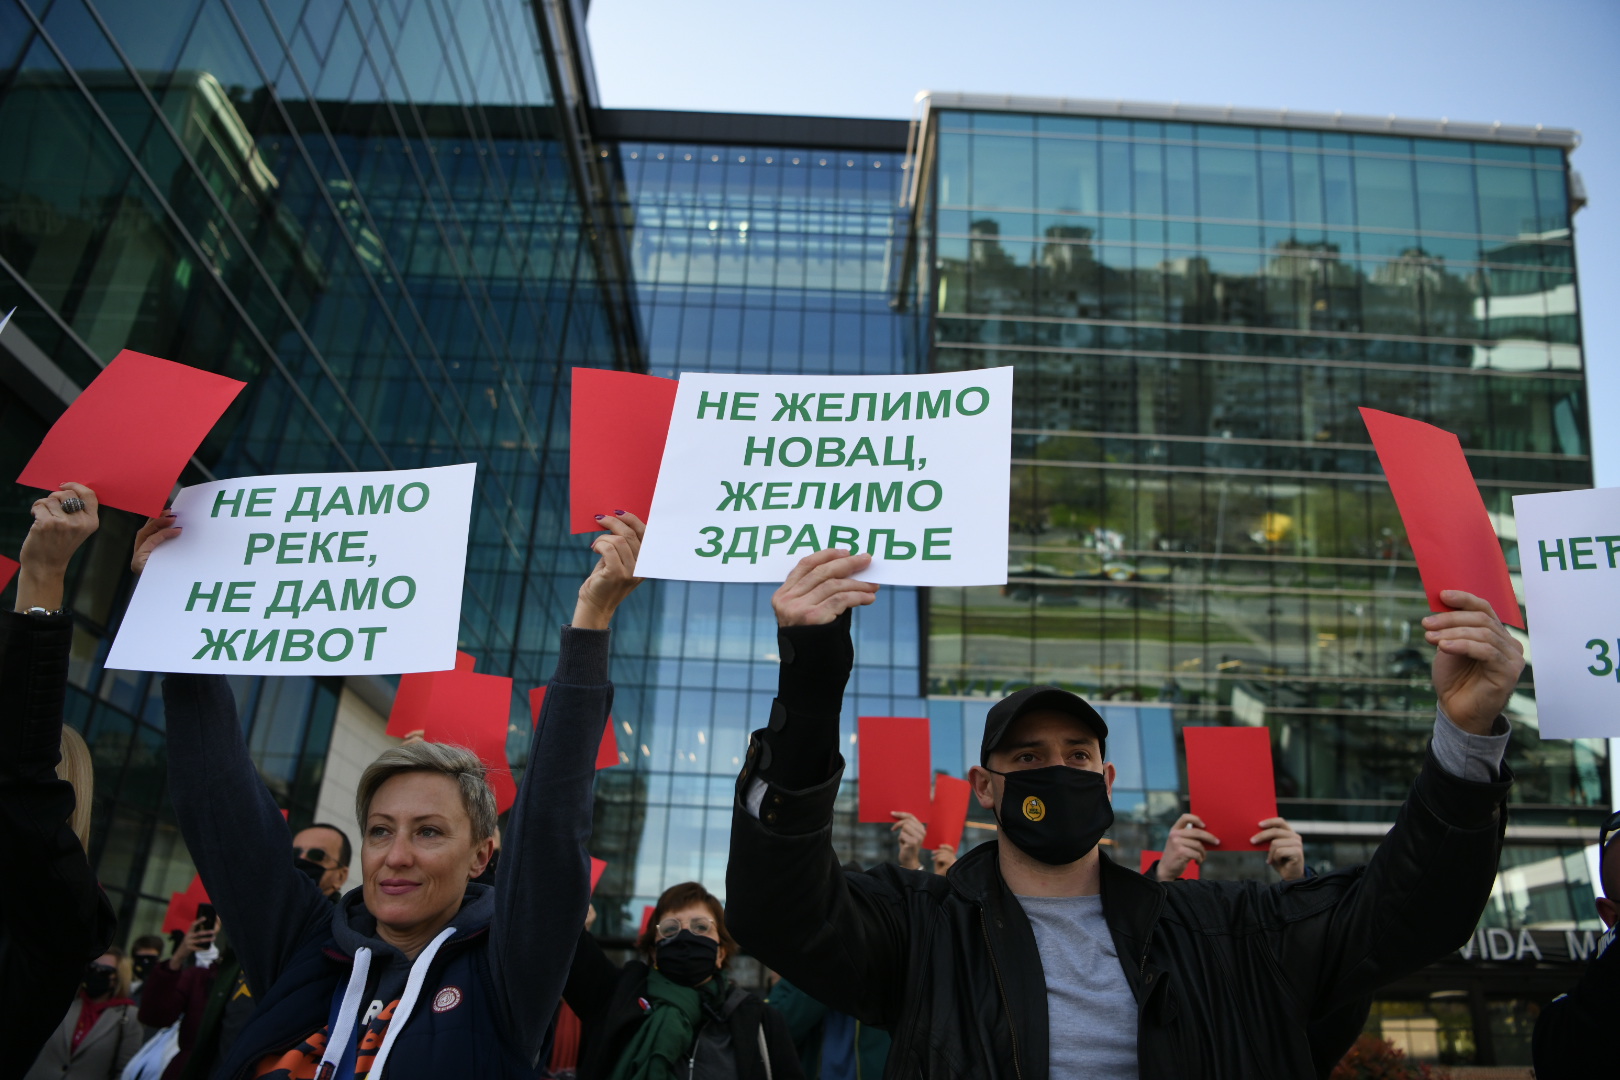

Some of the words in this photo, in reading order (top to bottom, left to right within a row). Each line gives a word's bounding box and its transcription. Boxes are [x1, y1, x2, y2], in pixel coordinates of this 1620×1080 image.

[696, 390, 760, 421] НЕ
[771, 386, 990, 422] ЖЕЛИМО
[743, 435, 927, 472] НОВАЦ,
[210, 487, 277, 518] НЕ
[284, 481, 430, 523] ДАМО
[716, 480, 943, 513] ЖЕЛИМО
[243, 530, 377, 568] РЕКЕ,
[694, 523, 953, 565] ЗДРАВЉЕ
[184, 581, 257, 613] НЕ
[263, 575, 417, 619] ДАМО
[191, 626, 387, 662] ЖИВОТ
[1585, 638, 1620, 682] З
